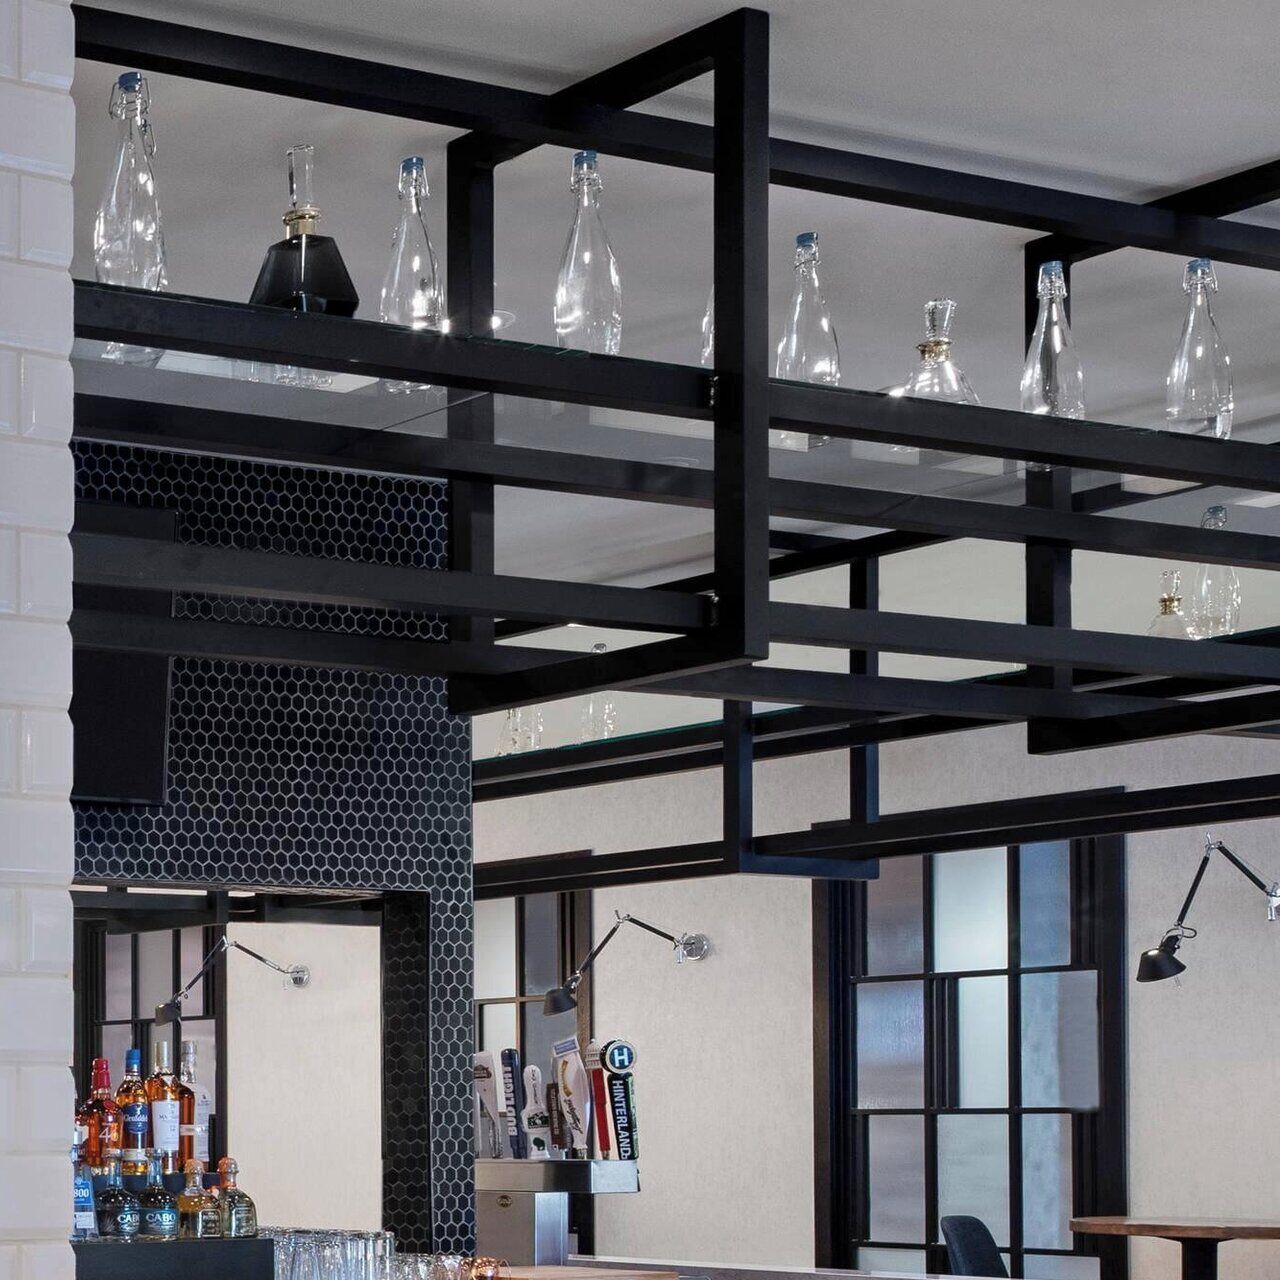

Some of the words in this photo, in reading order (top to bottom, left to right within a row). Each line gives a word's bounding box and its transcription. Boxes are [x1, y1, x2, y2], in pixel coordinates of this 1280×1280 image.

[504, 1066, 515, 1104] LIGHT
[507, 1106, 518, 1136] BUD
[612, 1080, 631, 1157] HINTERLAND
[117, 1214, 139, 1223] CAB
[146, 1213, 175, 1223] CABO
